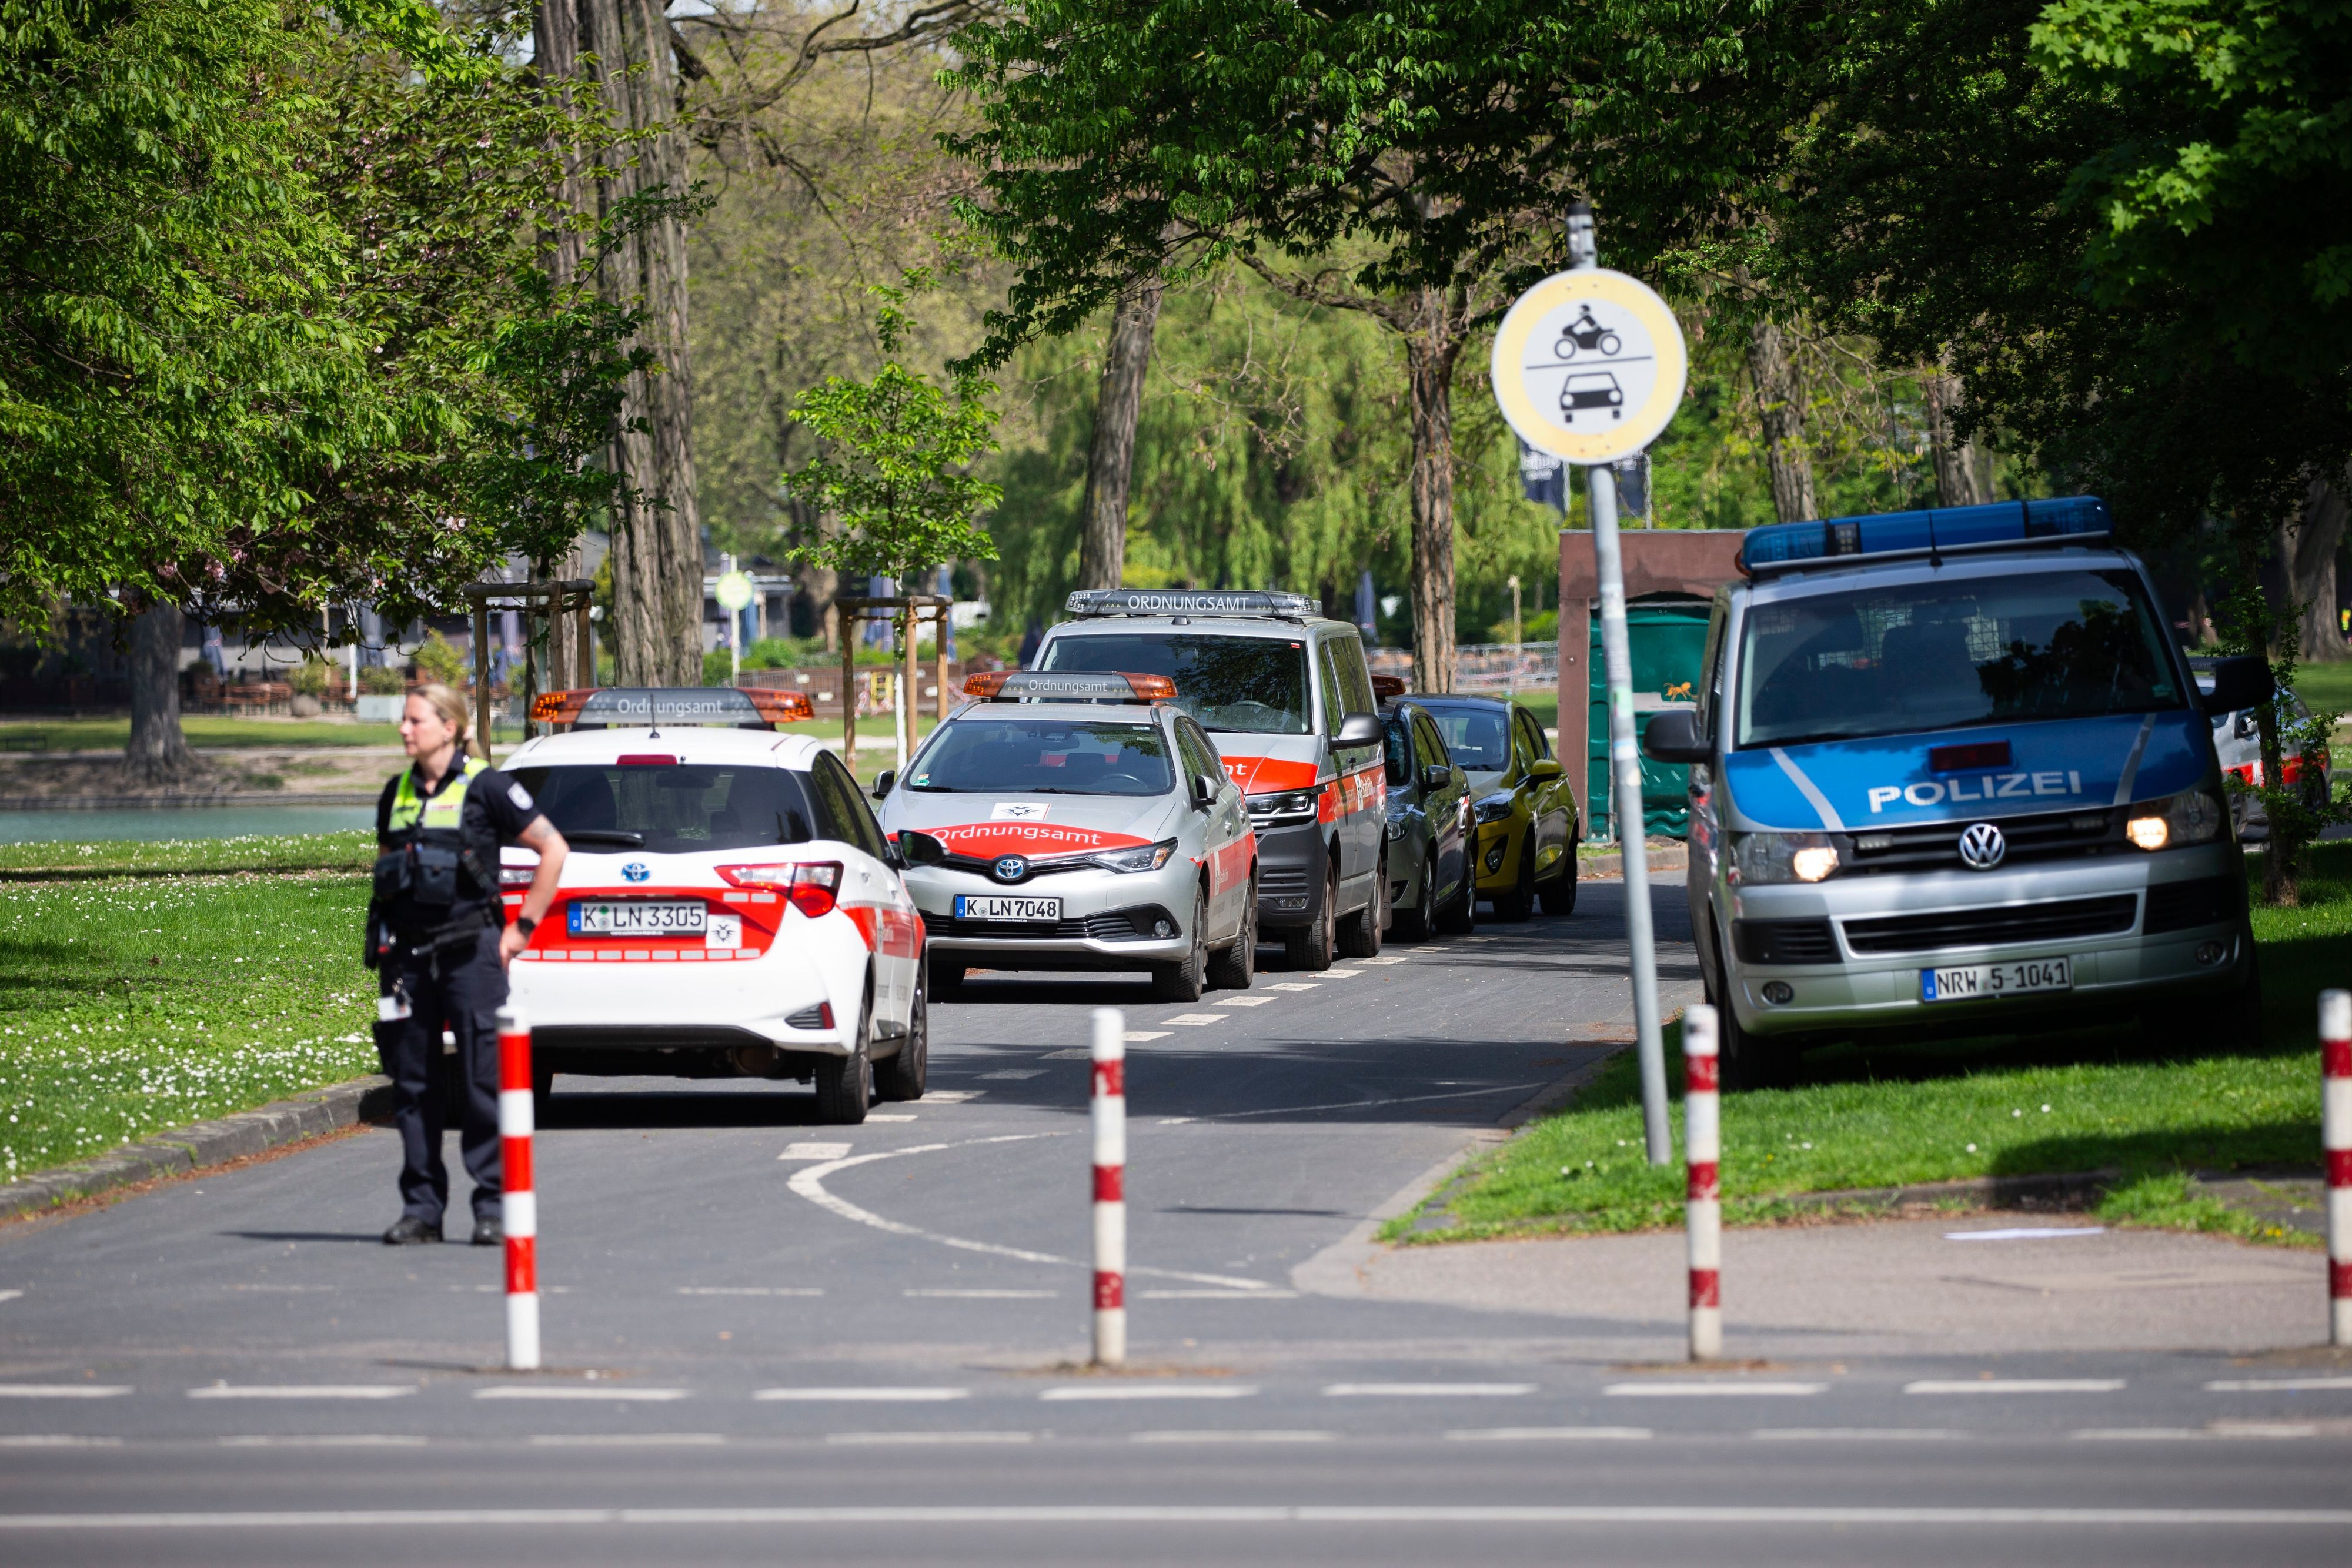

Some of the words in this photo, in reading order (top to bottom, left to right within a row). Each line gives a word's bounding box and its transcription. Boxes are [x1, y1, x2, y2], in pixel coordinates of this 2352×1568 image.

[1128, 595, 1249, 611] ORDNUNGSAMT
[1028, 679, 1108, 694] Ordnungsamt
[1867, 770, 2082, 814] POLIZEI
[931, 825, 1102, 845] Ordnungsamt
[584, 907, 597, 927] K
[613, 907, 642, 927] LN
[647, 907, 702, 927] 3305
[967, 900, 977, 915] K
[989, 900, 1011, 916] LN
[1015, 900, 1057, 917] 7048
[1937, 971, 1977, 995] NRW
[1990, 962, 2068, 990] 5-1041
